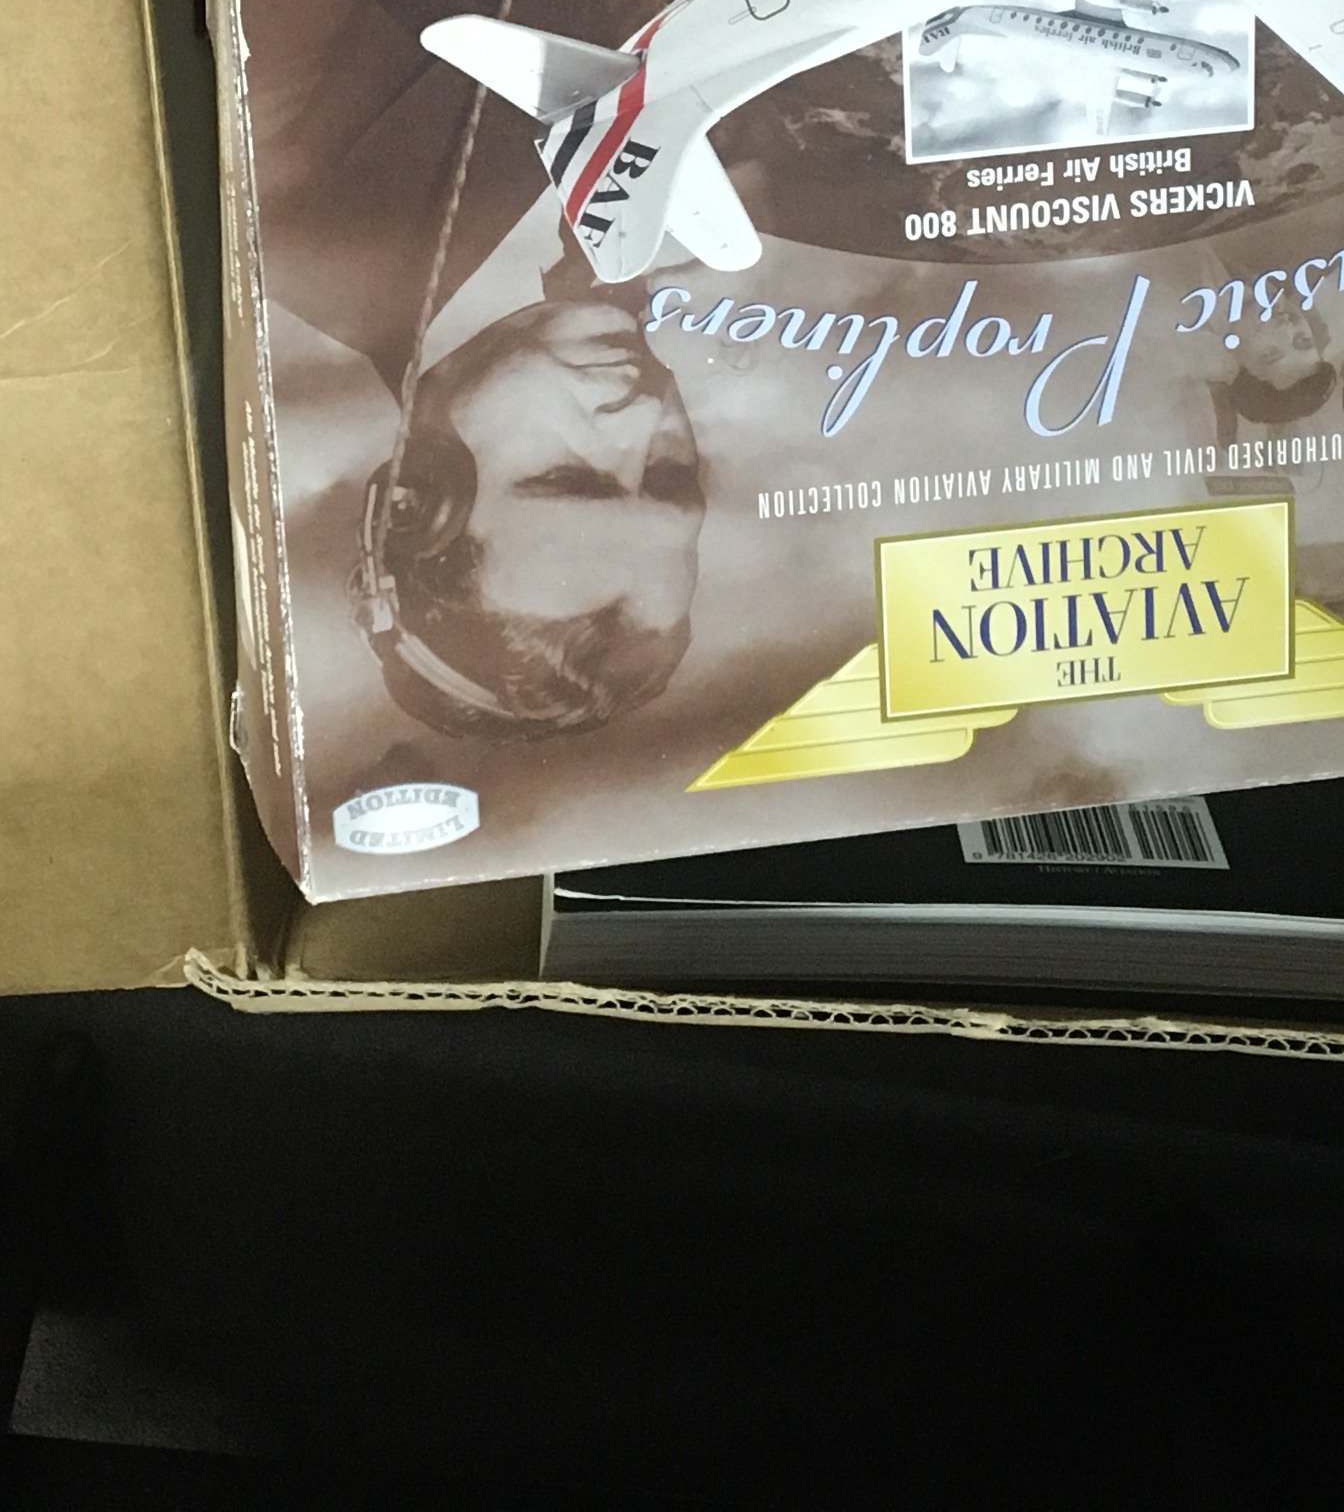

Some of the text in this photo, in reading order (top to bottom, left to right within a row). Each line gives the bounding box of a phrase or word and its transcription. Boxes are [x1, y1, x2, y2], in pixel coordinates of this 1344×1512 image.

[966, 148, 1192, 191] British Air Ferries
[578, 137, 662, 249] BAF
[905, 179, 1256, 241] VICKERS VISCOUNT 800
[644, 275, 1152, 439] Propliners
[1002, 457, 1101, 494] MILITARY
[1112, 452, 1153, 482] AND
[1163, 446, 1217, 476] CIVIL
[758, 480, 882, 520] COLLECTION
[893, 468, 992, 505] AVIATION
[968, 525, 1207, 593] ARCHIVE
[929, 576, 1250, 664] AVIATION
[1056, 655, 1122, 688] THE
[345, 788, 462, 821] EDITION
[348, 814, 465, 848] LIMITED
[971, 851, 984, 860] 9
